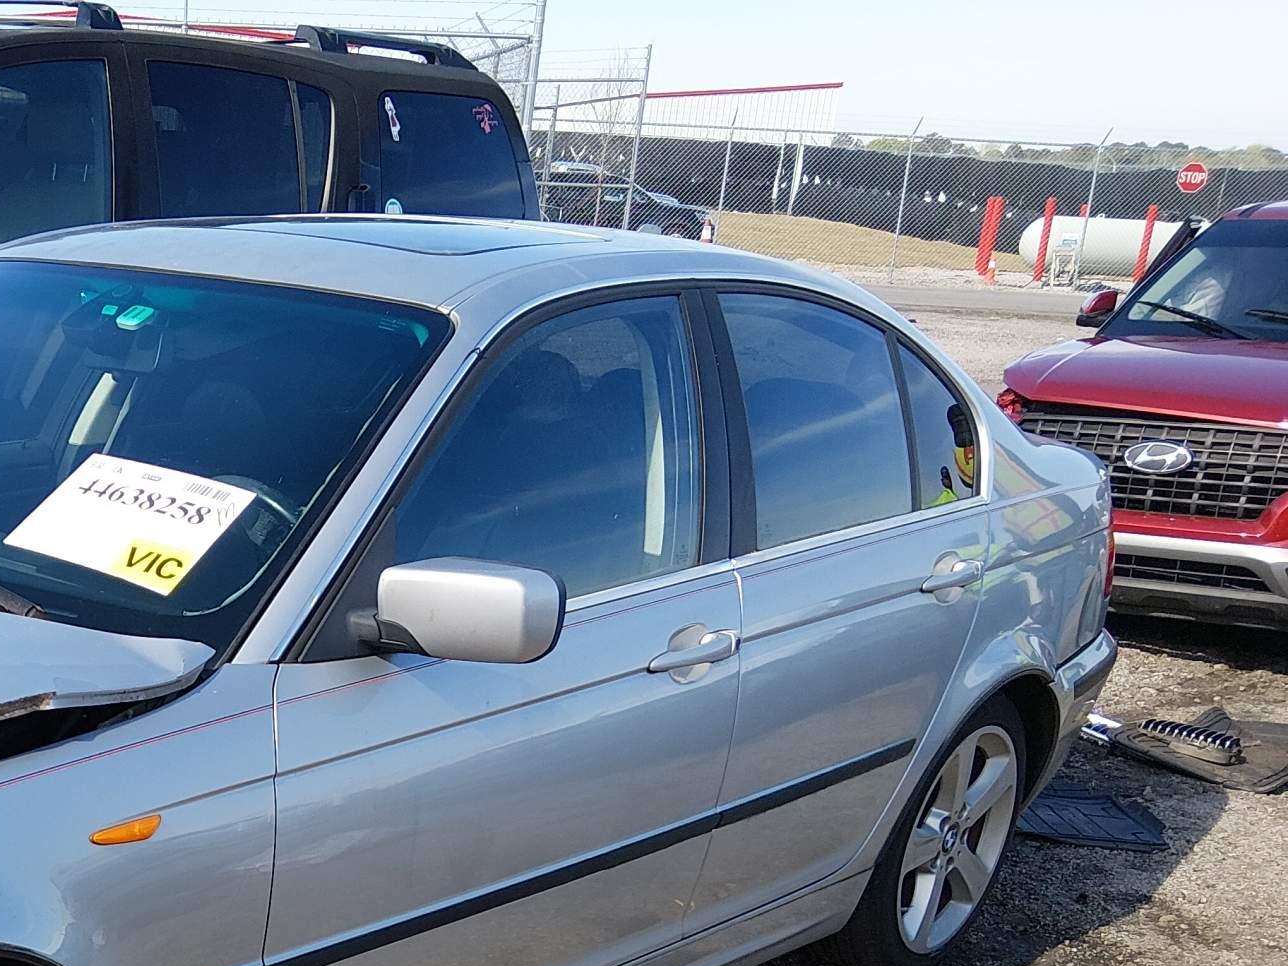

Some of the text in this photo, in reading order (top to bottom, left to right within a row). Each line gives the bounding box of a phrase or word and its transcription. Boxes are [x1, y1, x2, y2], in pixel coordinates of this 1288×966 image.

[1179, 172, 1206, 184] STOP
[78, 479, 212, 525] 44638258
[125, 546, 183, 580] VIC
